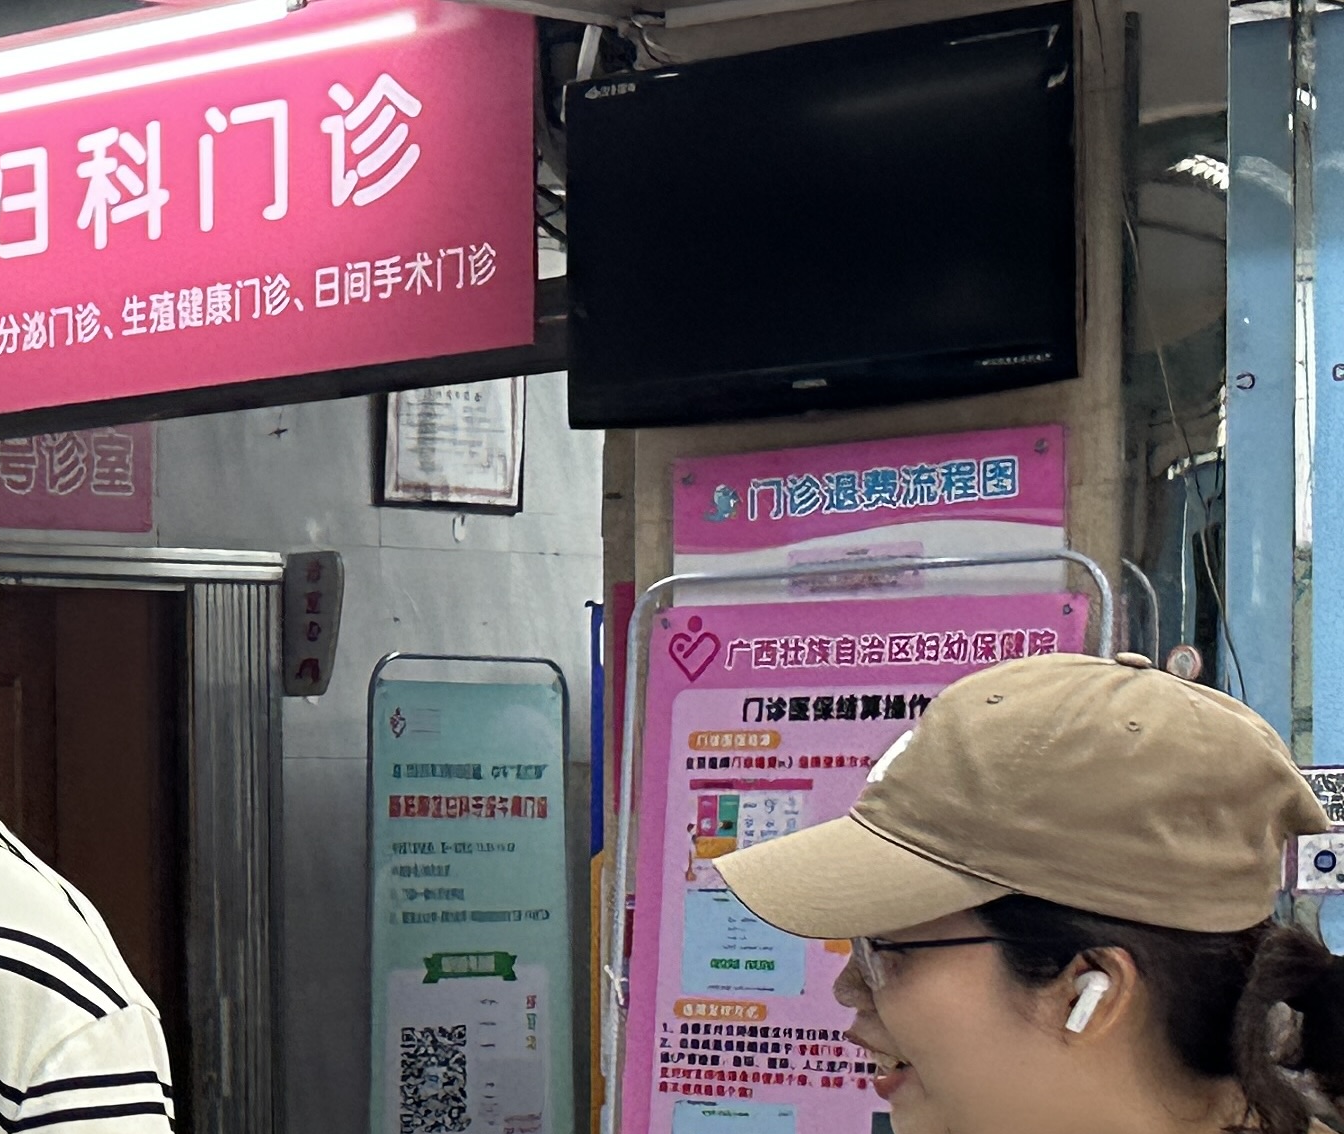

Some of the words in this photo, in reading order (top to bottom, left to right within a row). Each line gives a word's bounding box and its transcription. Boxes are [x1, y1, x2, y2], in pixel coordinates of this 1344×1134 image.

[748, 456, 1019, 521] 门诊退费流程图
